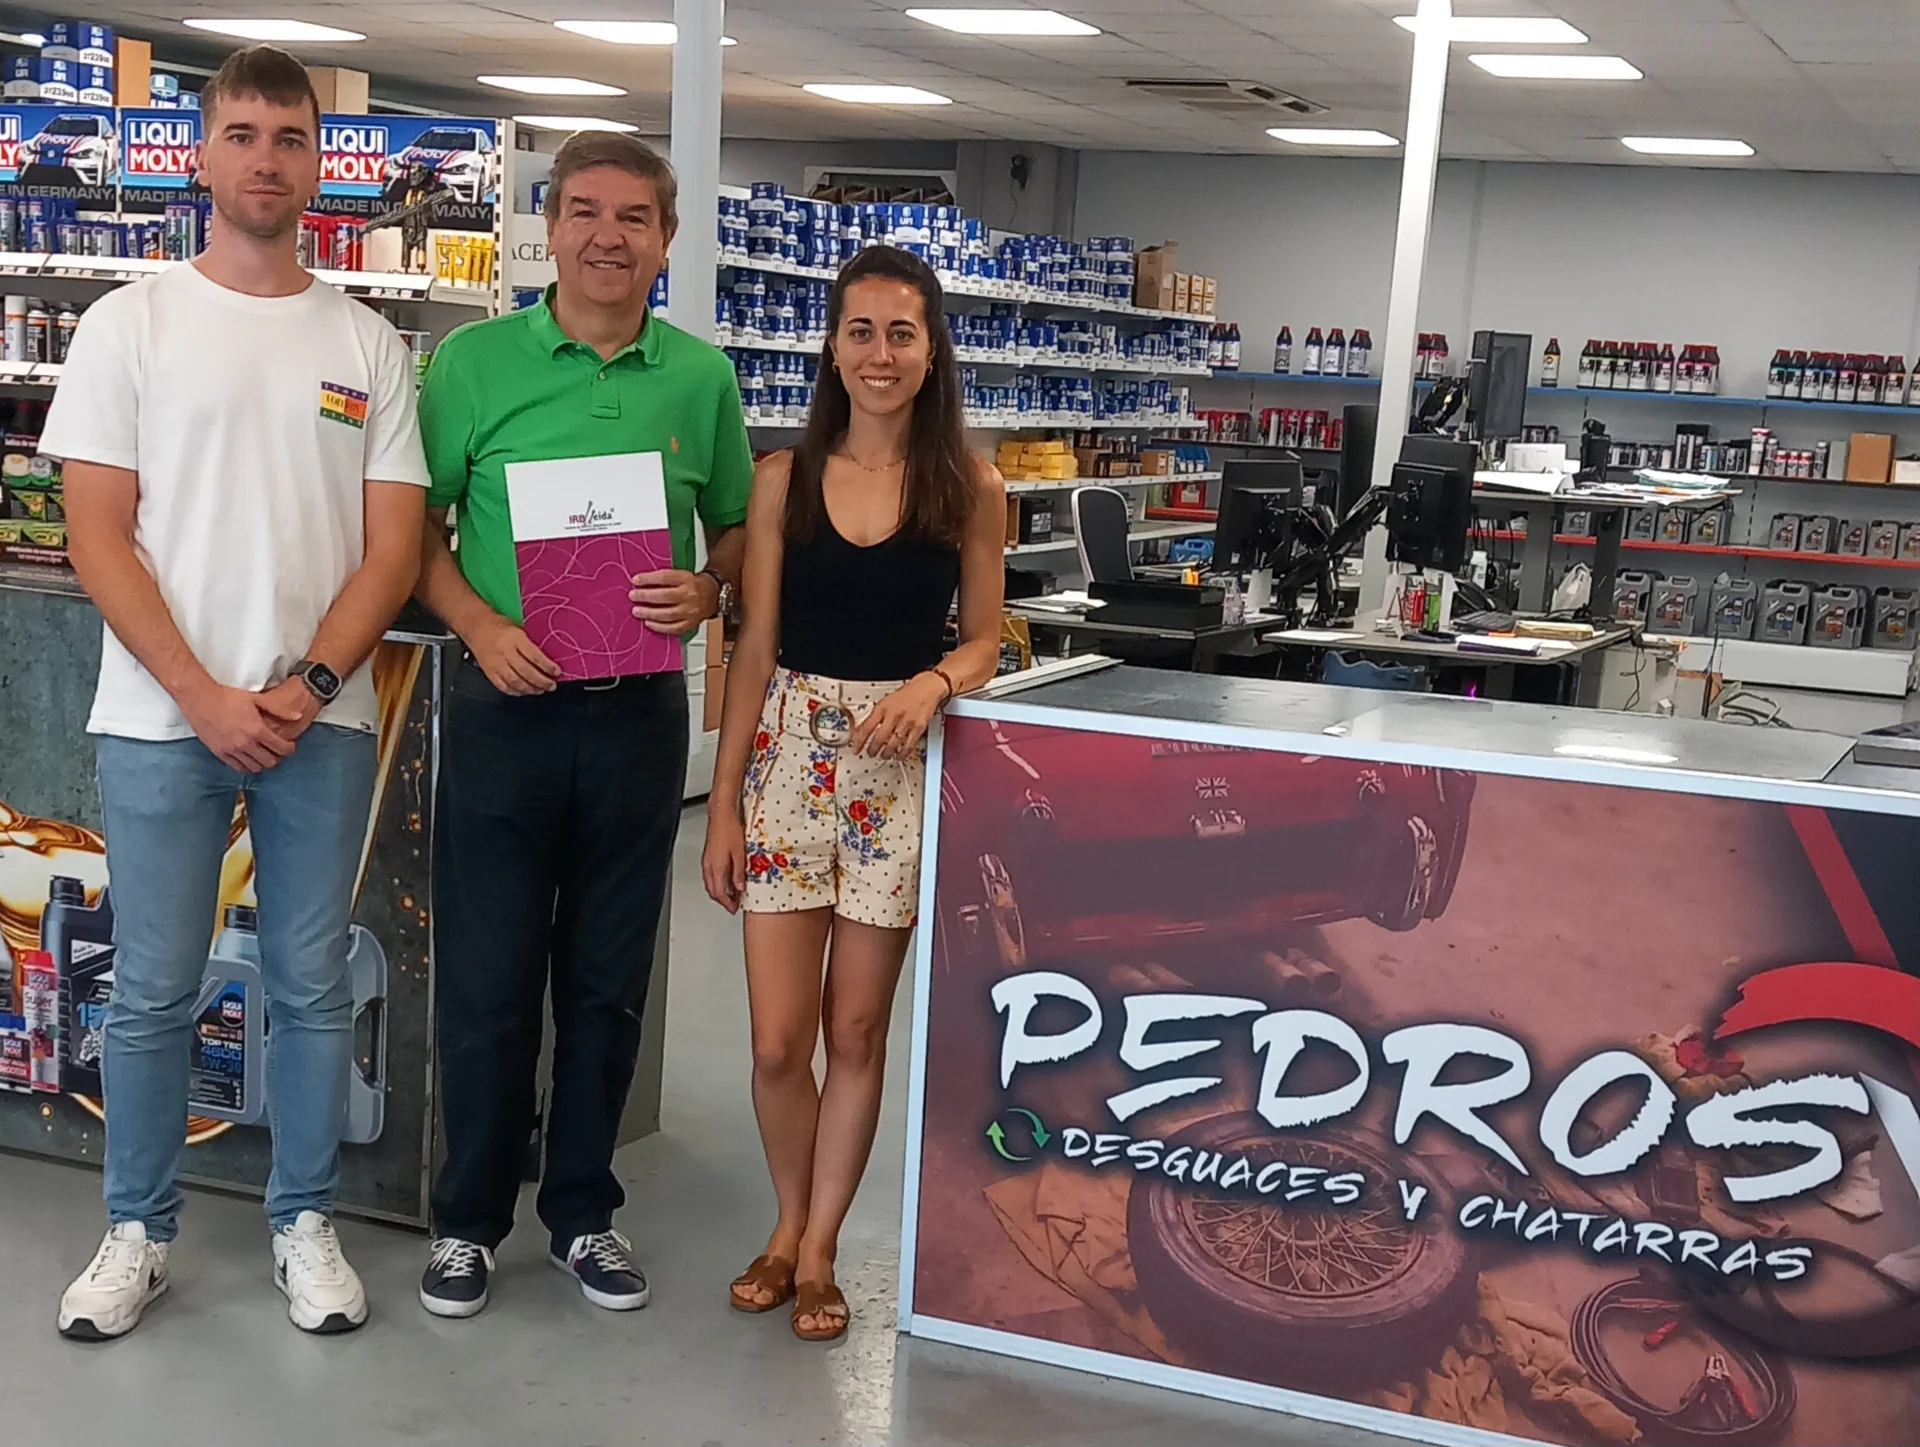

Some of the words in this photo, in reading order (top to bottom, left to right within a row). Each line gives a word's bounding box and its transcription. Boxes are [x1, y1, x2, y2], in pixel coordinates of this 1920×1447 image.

[130, 121, 189, 146] LIQUI
[321, 128, 384, 154] LIQUI
[130, 148, 191, 172] MOLY
[320, 155, 385, 180] MOLY
[125, 190, 176, 203] MADE
[314, 197, 369, 213] MADE
[371, 199, 390, 214] IN
[201, 1036, 222, 1046] TOP
[223, 1040, 243, 1051] TEC
[991, 971, 1870, 1201] PEDROS
[1062, 1128, 1365, 1203] DESGUACES
[1459, 1194, 1812, 1280] CHATARRAS
